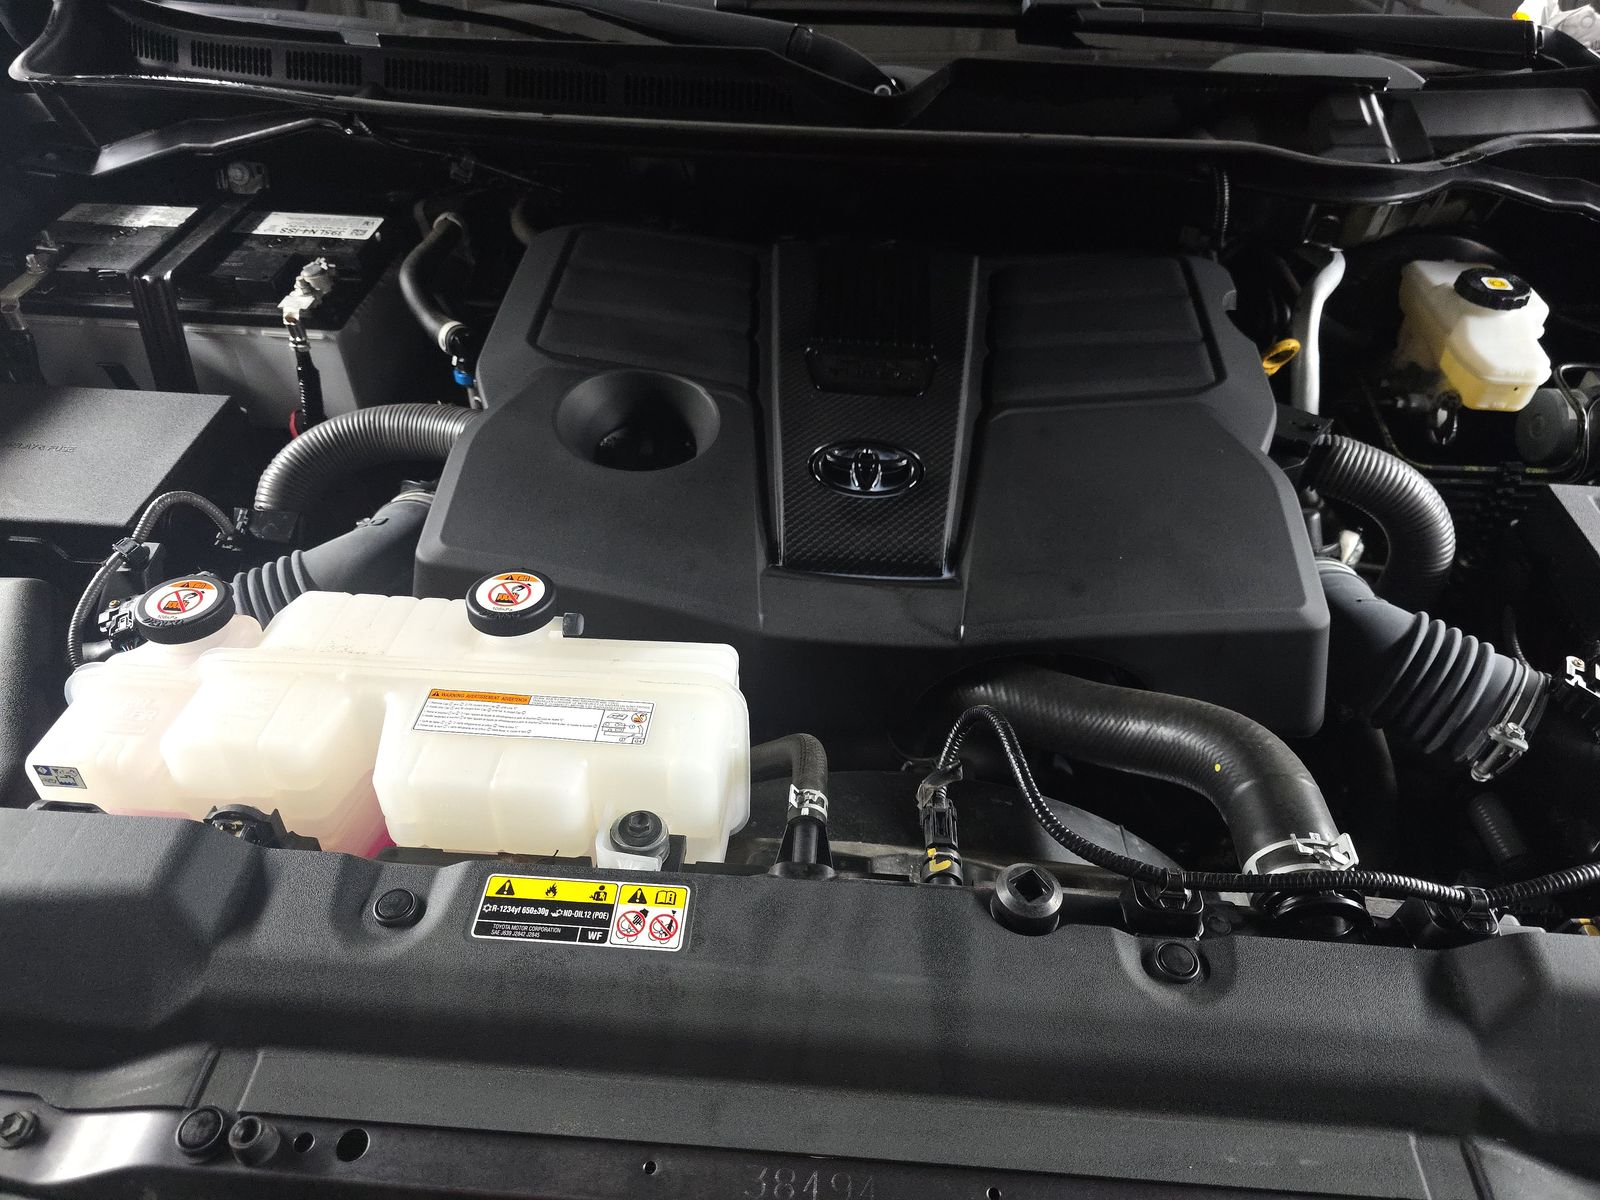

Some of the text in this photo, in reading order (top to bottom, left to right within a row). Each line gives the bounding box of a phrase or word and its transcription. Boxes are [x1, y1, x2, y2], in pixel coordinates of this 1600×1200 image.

[492, 904, 521, 914] R-1234yf
[521, 906, 550, 917] 650±30g
[588, 931, 603, 940] WF
